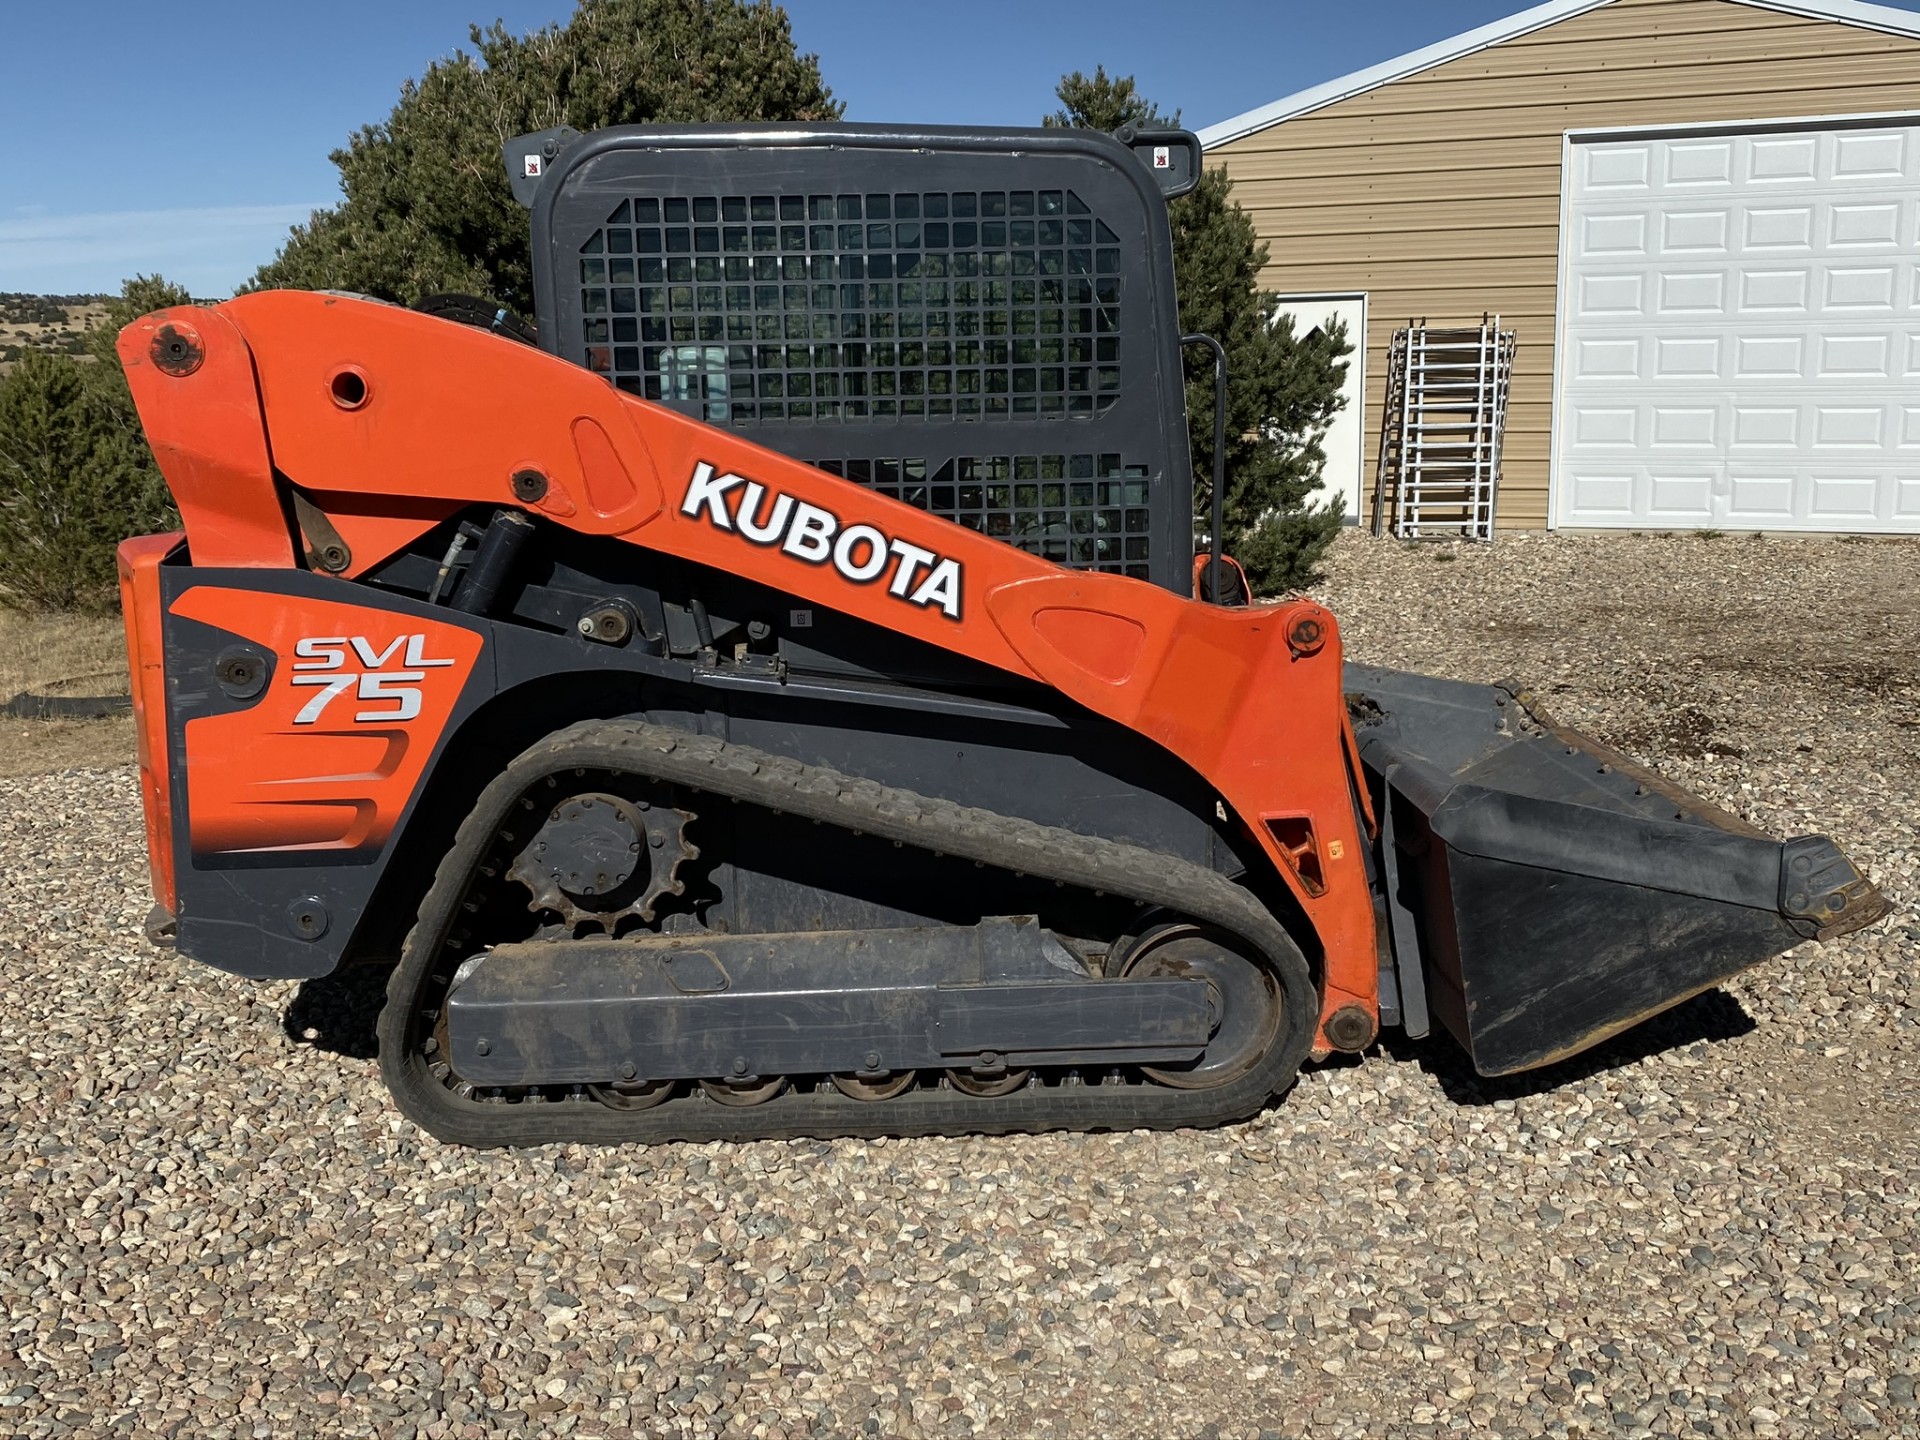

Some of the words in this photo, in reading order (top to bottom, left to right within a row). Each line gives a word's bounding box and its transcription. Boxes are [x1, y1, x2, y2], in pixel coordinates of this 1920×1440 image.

[680, 460, 961, 619] KUBOTA
[292, 634, 456, 671] SVL
[291, 671, 426, 725] 75
